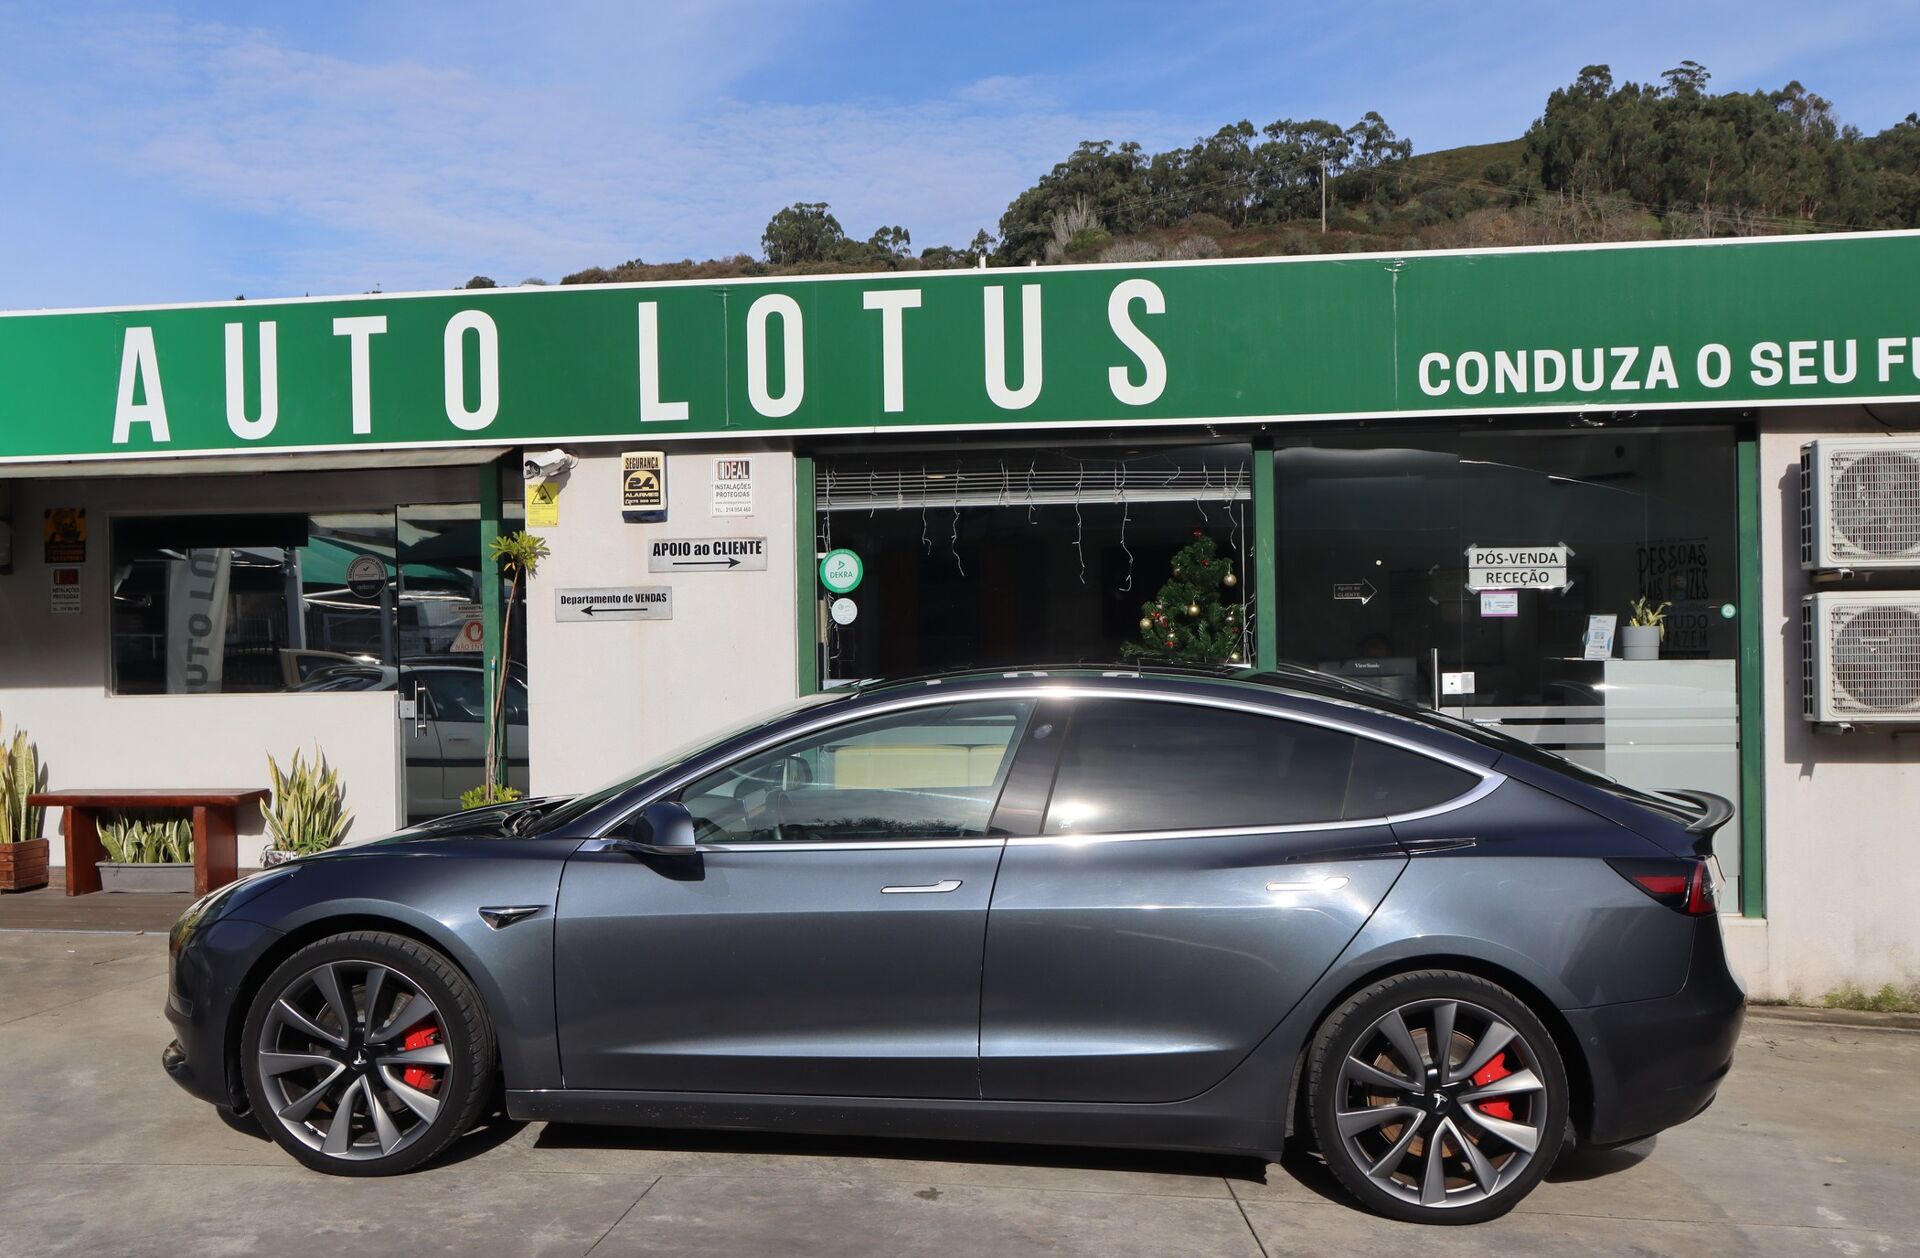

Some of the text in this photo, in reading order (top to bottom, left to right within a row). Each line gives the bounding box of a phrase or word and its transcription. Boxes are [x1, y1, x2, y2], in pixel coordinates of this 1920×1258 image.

[112, 278, 1168, 444] AUTO LOTUS
[1418, 346, 1679, 396] CONDUZA
[1696, 343, 1731, 388] O
[1750, 338, 1858, 387] SEU
[719, 461, 749, 480] IDEAL
[628, 476, 654, 490] 24
[714, 482, 751, 491] INSTALAÇÕES
[652, 540, 762, 557] APOIO ao CLIENTE
[1476, 550, 1559, 565] PÓS-VENDA
[829, 571, 854, 579] DEKRA
[1486, 569, 1550, 586] RECEÇÃO
[560, 592, 667, 605] Departamento de VENDAS
